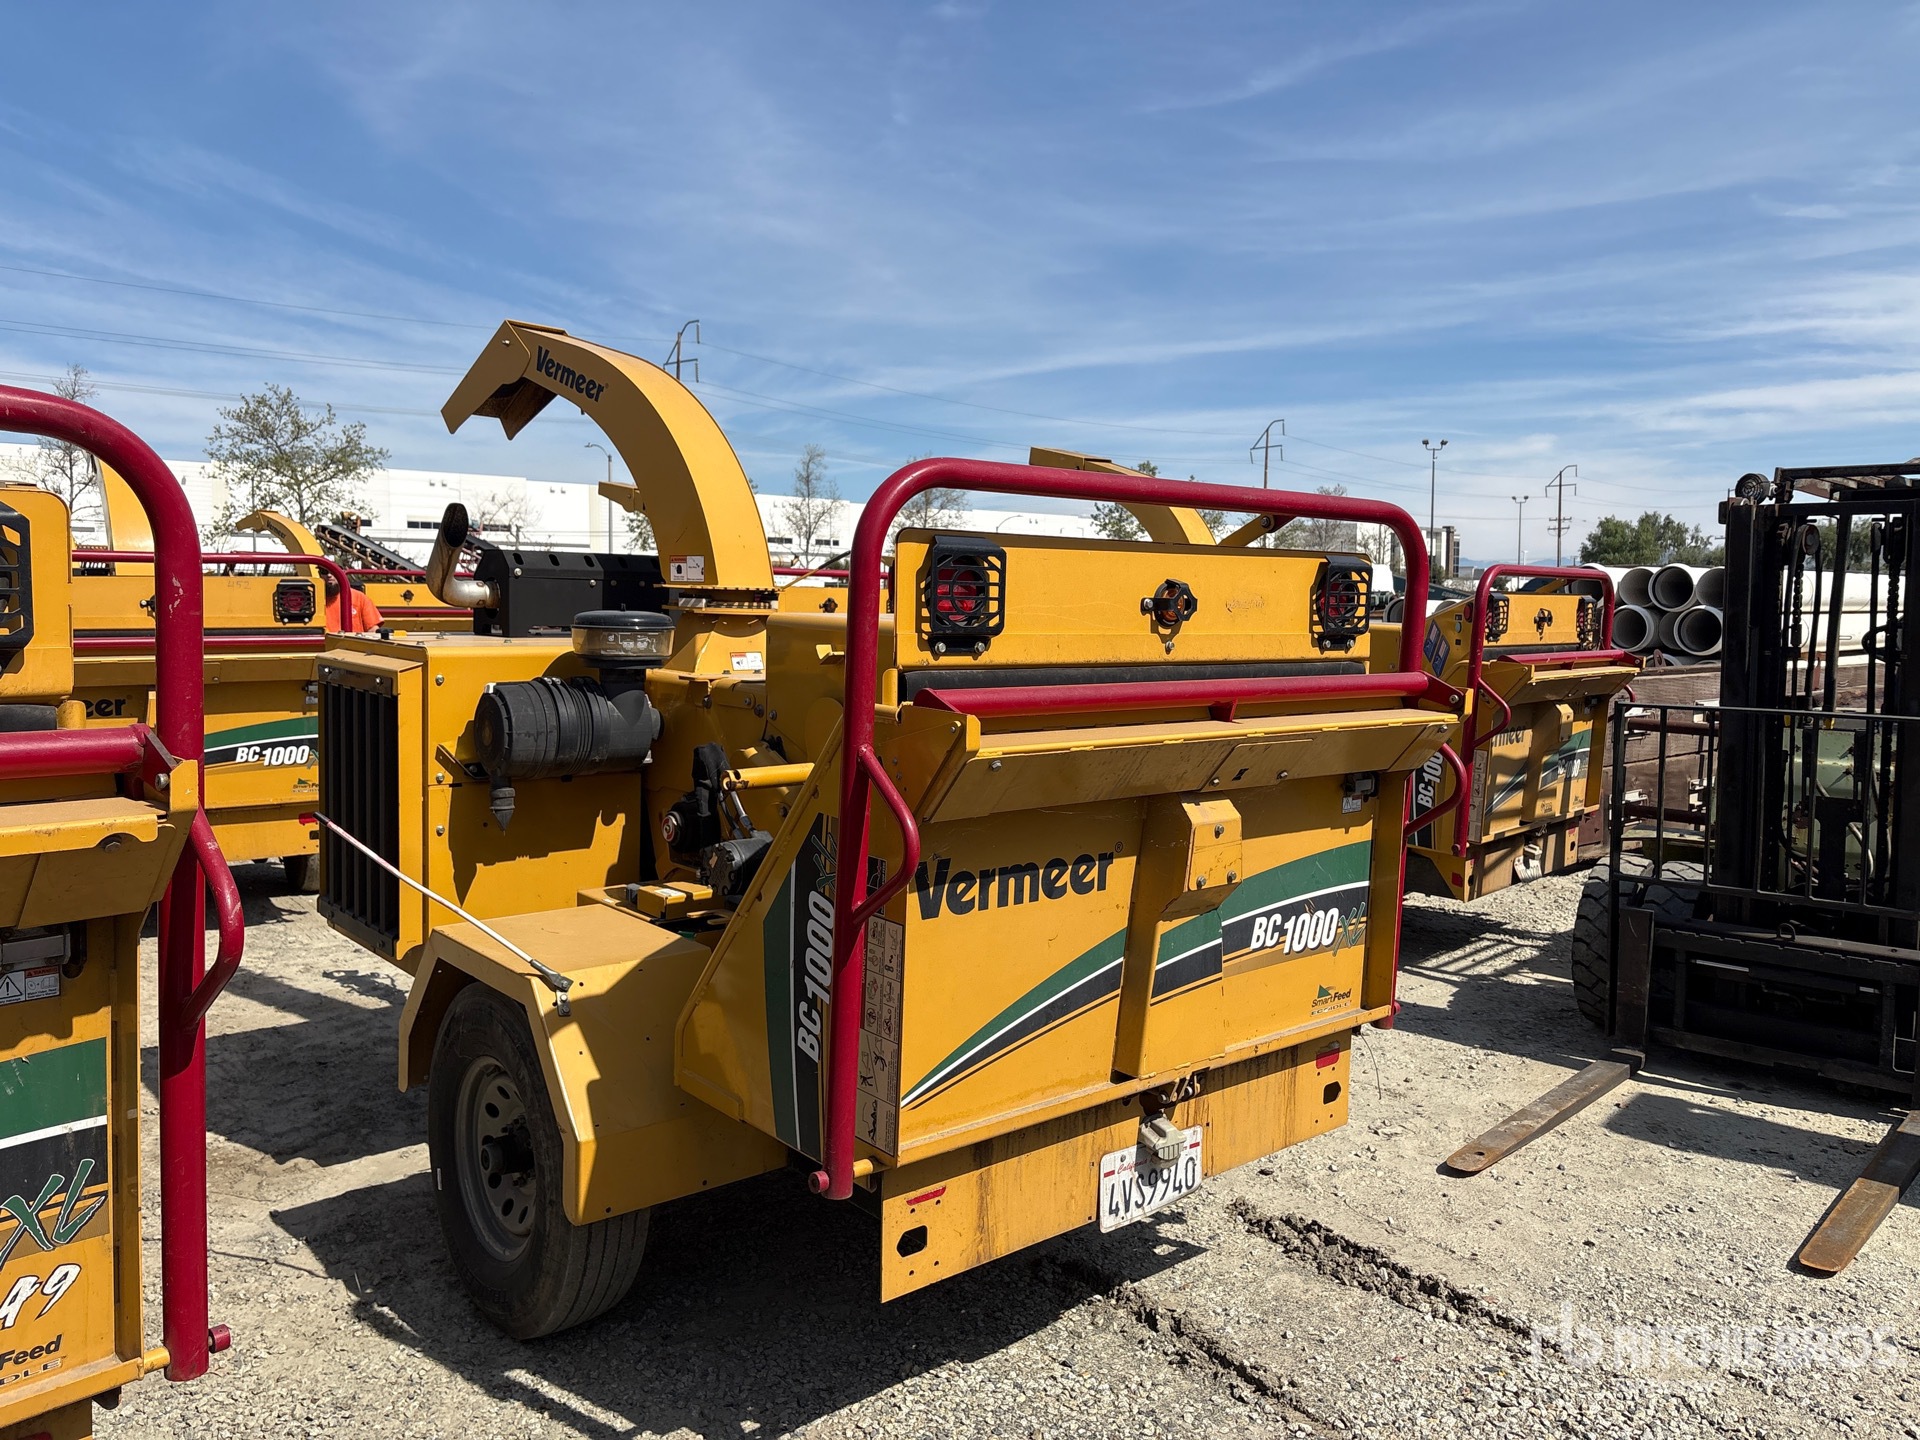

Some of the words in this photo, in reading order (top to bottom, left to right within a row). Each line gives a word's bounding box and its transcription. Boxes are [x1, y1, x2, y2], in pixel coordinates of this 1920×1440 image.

[536, 345, 605, 402] Vermeer
[235, 746, 260, 763] BC
[263, 745, 310, 767] 1000
[1417, 783, 1434, 808] BC
[915, 851, 1114, 921] Vermeer
[804, 890, 835, 1006] 1000
[1250, 913, 1282, 951] BC
[1283, 907, 1340, 955] 1000
[1332, 901, 1367, 957] XL
[797, 1001, 821, 1064] BC
[0, 1159, 105, 1271] XL
[1108, 1156, 1197, 1217] 4VS9940
